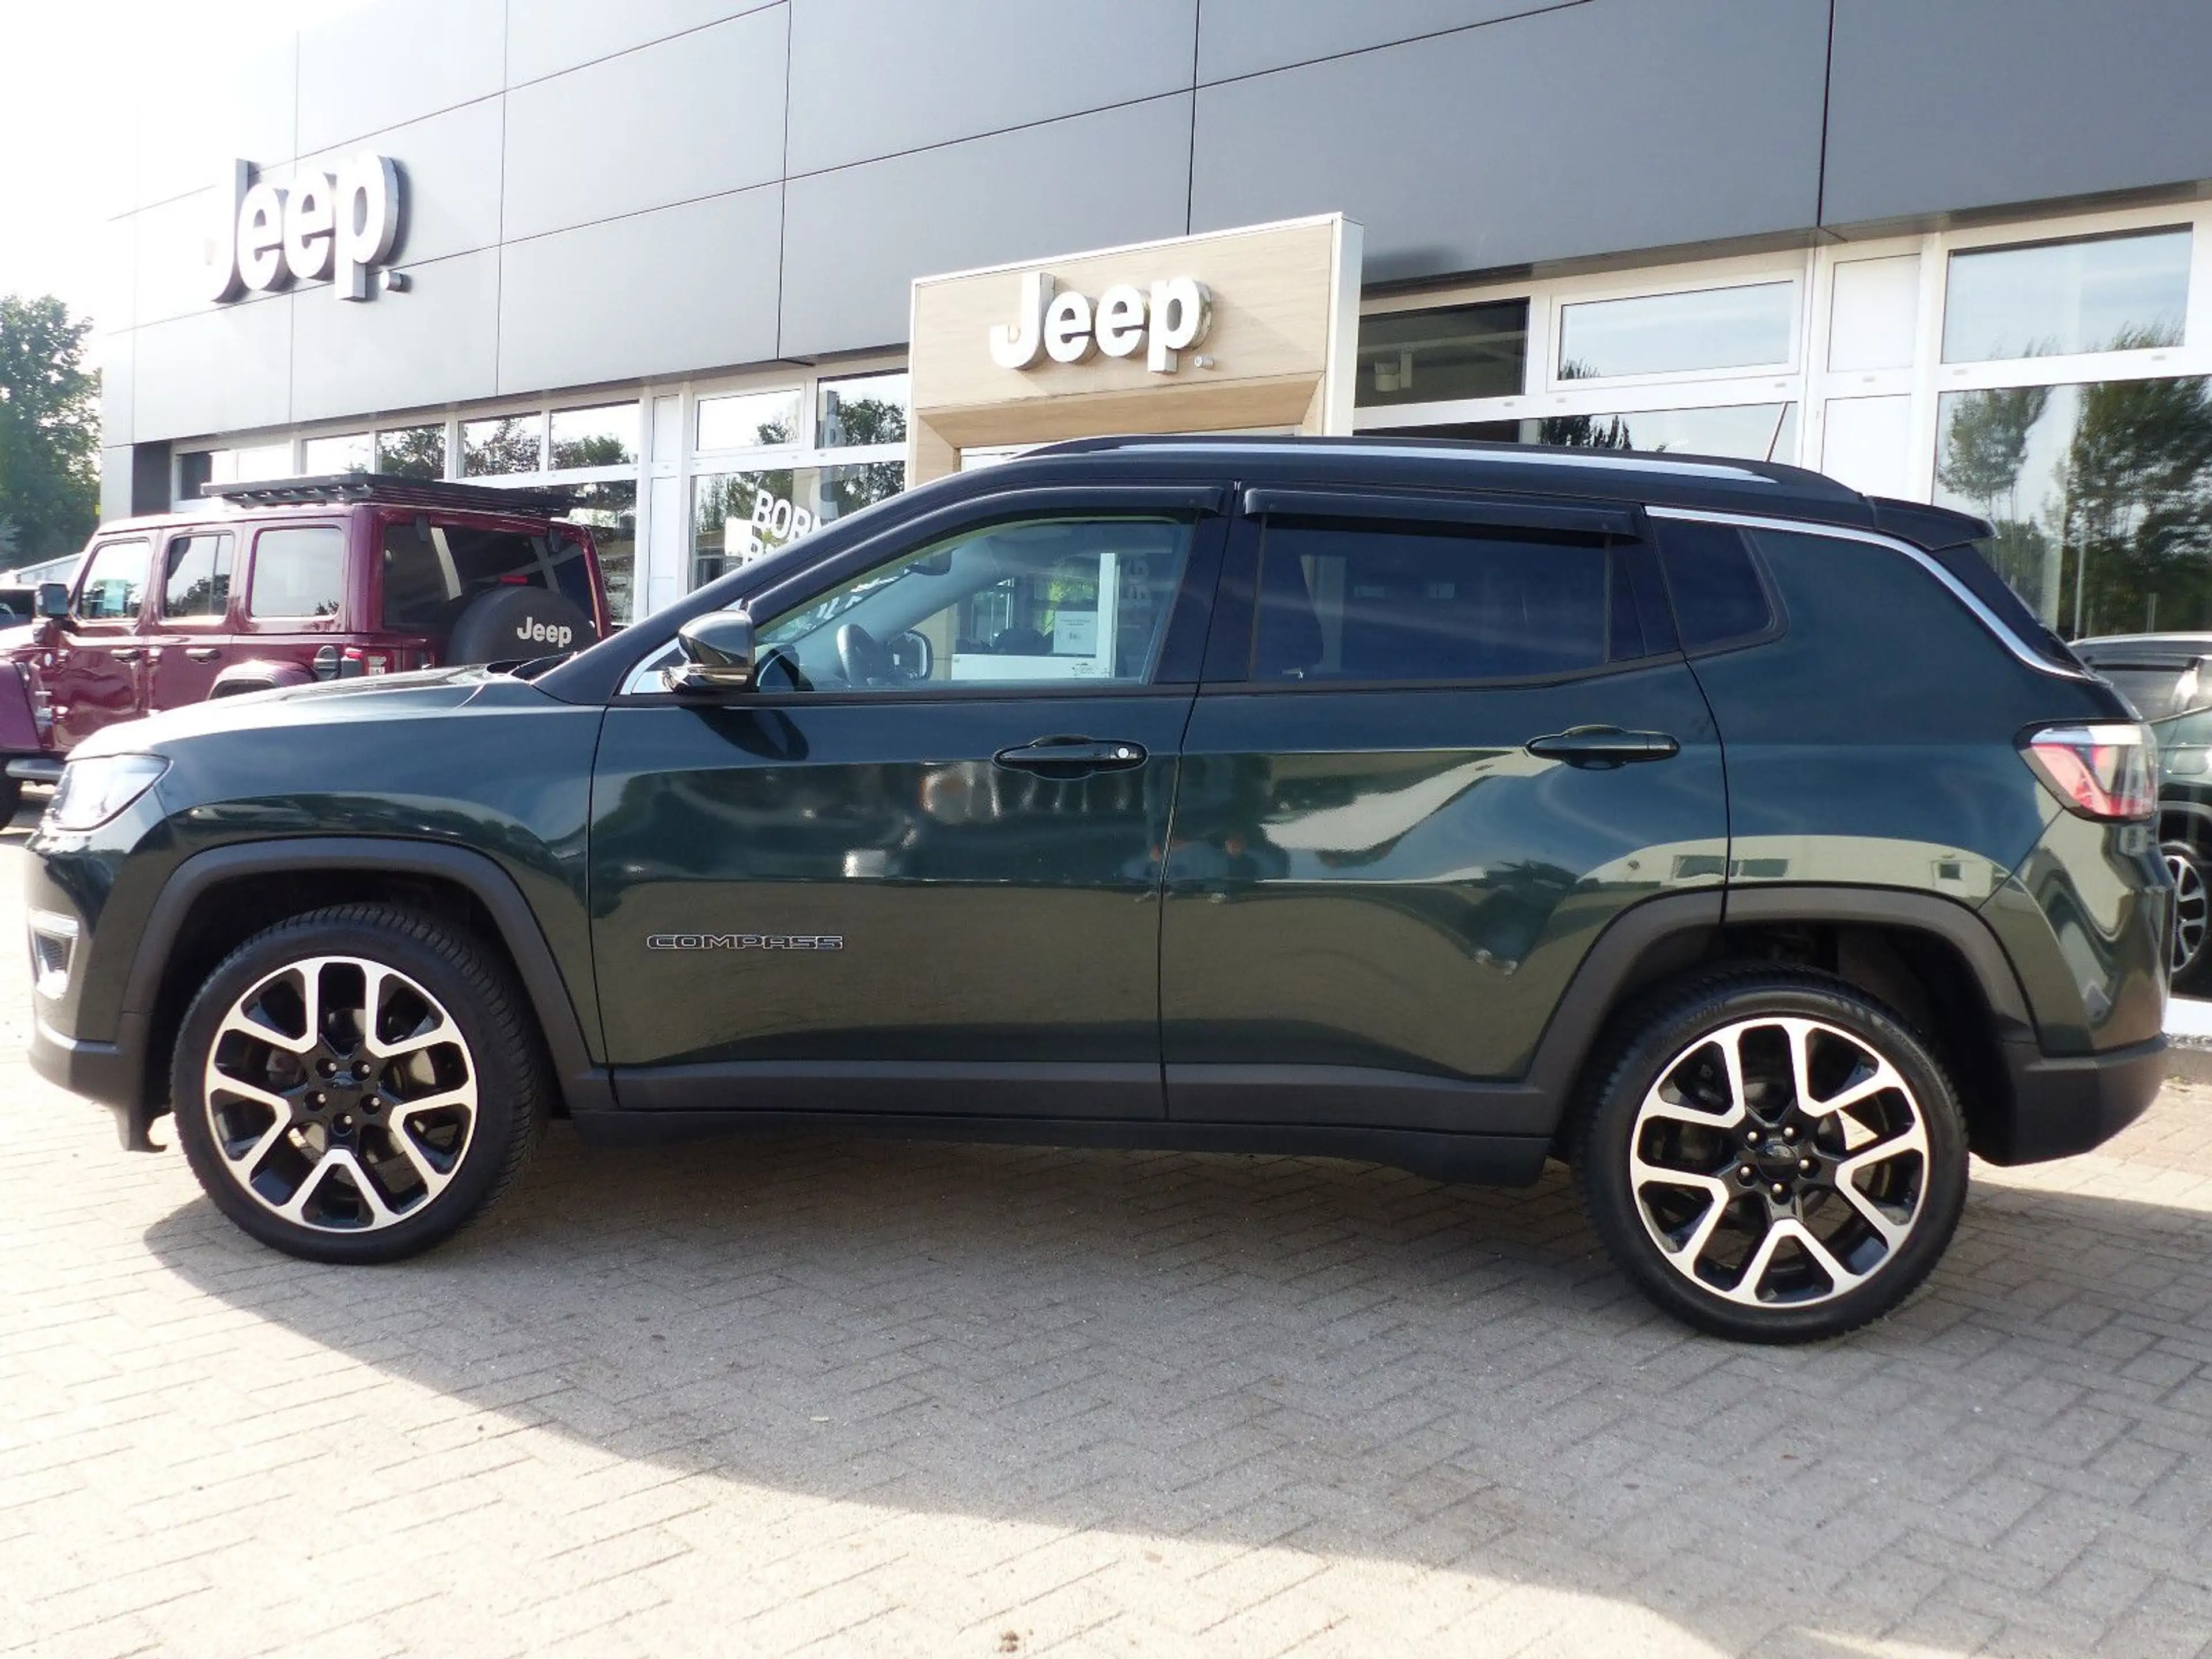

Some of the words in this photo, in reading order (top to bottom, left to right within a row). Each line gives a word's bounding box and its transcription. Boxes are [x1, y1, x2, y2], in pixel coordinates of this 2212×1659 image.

[989, 271, 1211, 374] Jeep
[517, 616, 572, 648] Jeep
[646, 934, 843, 950] COMPASS
